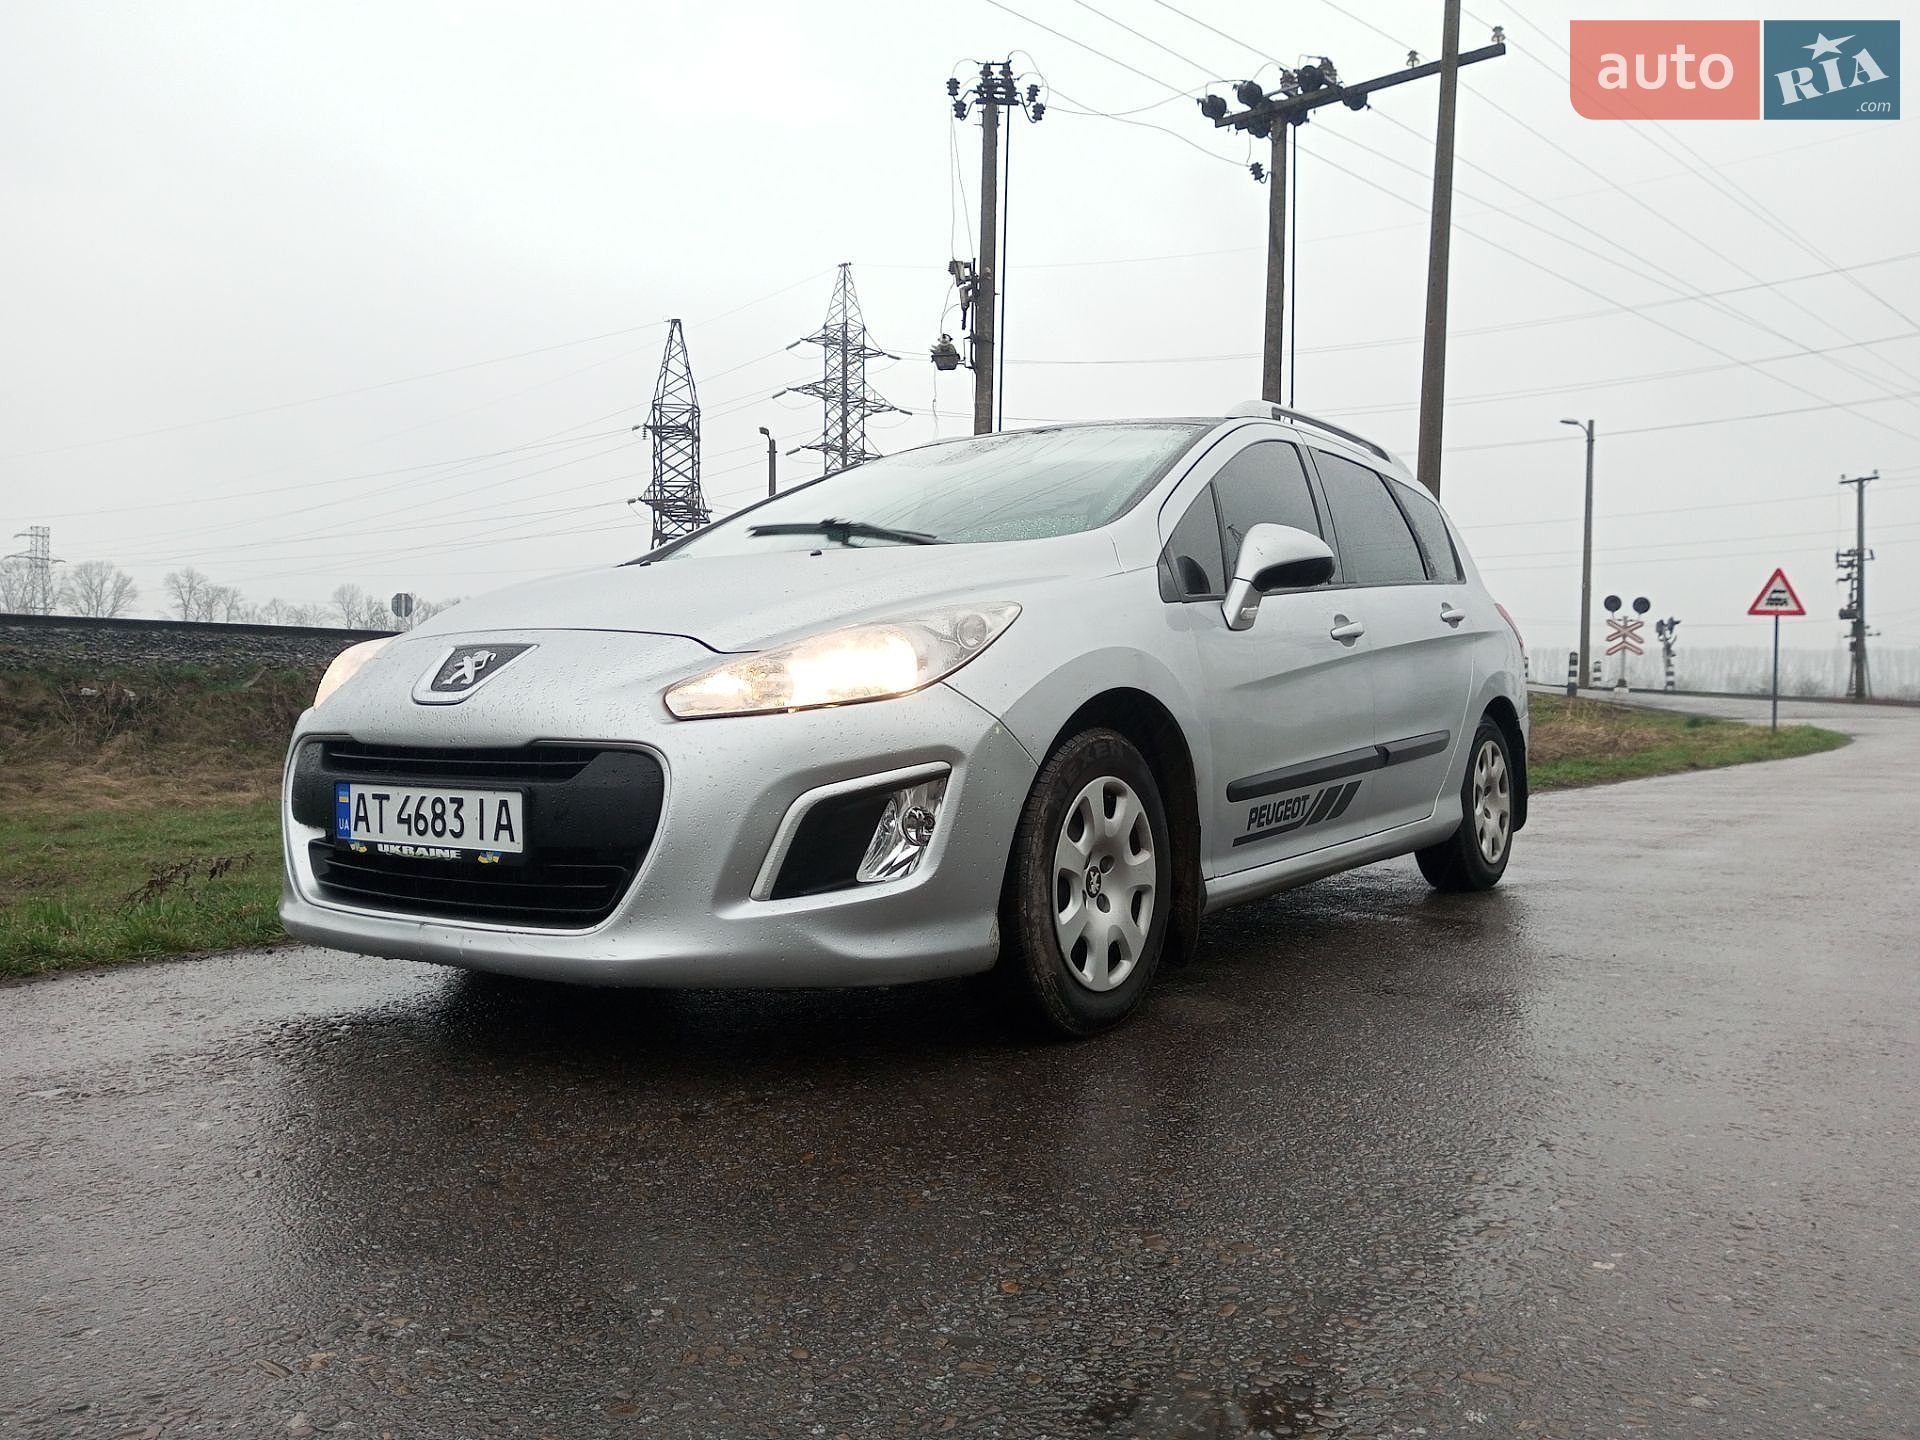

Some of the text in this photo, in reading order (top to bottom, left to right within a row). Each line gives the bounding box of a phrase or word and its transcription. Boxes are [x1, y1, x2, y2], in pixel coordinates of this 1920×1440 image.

[338, 818, 350, 830] UA
[353, 792, 515, 843] AT 4683 IA
[1247, 794, 1310, 831] PEUGEOT
[377, 843, 463, 860] UKRAINE
